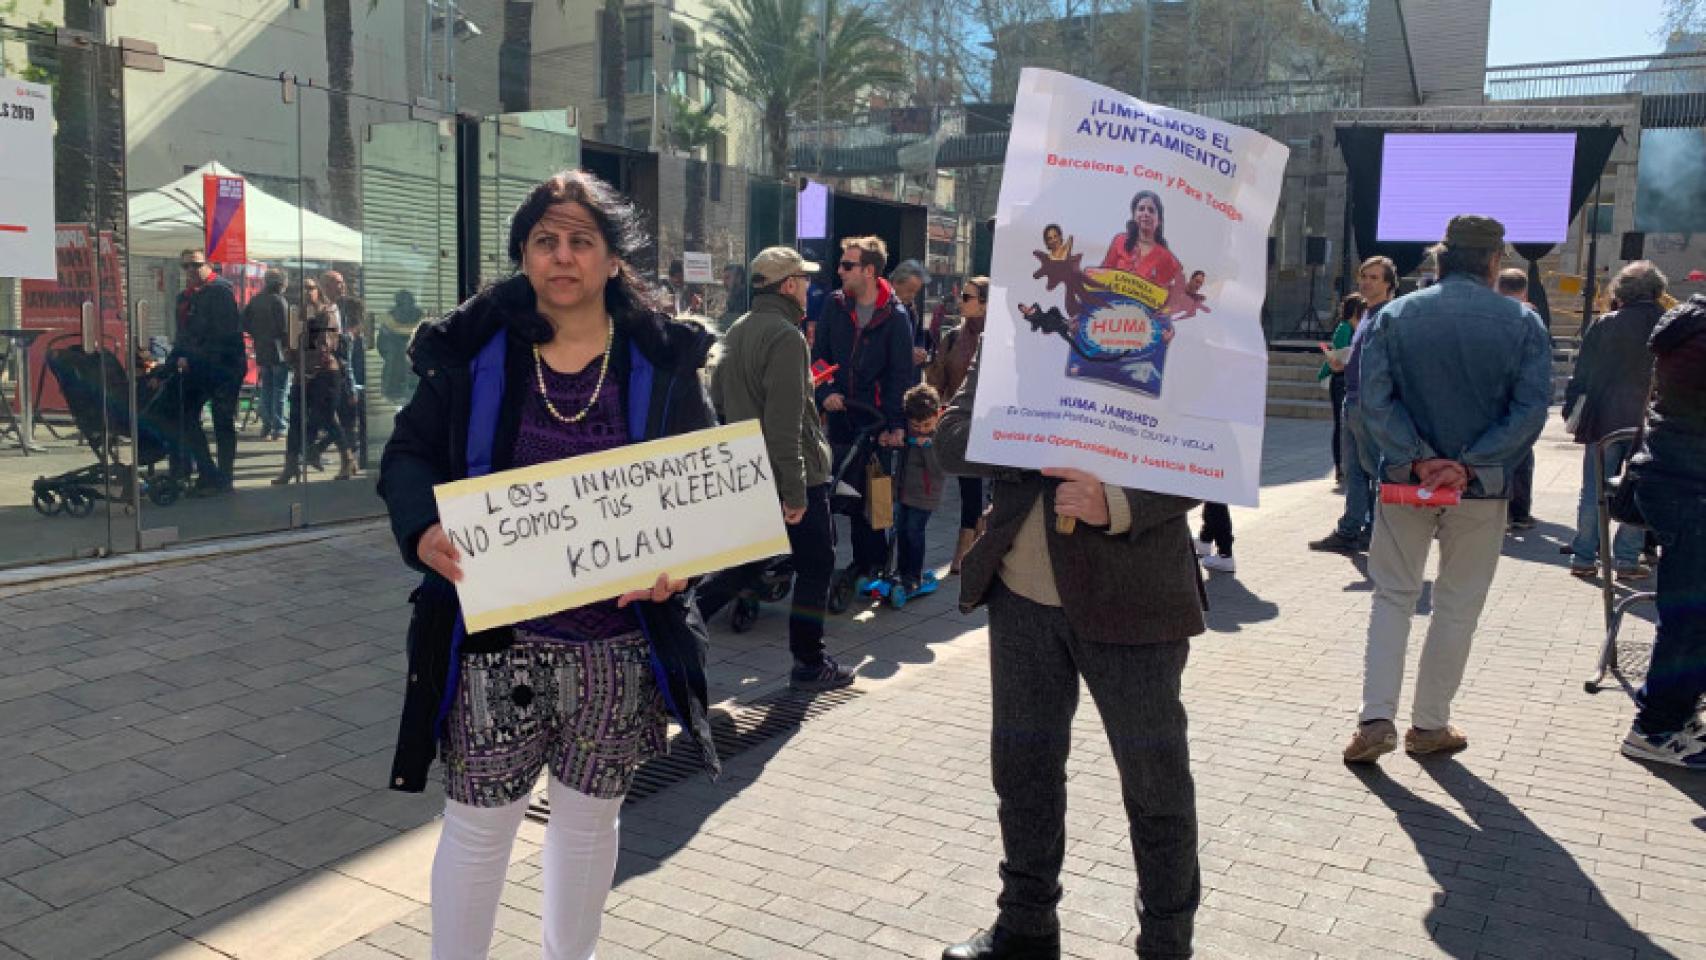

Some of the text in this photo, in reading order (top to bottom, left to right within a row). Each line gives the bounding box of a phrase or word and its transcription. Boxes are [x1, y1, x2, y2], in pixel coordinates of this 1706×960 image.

[1077, 118, 1237, 178] AYUNTAMIENTO!
[1091, 99, 1233, 154] ¡LIMPIEMOS EL
[1047, 153, 1128, 176] Barcelona,
[1133, 164, 1163, 181] Con
[1166, 176, 1176, 188] y
[1177, 177, 1203, 200] Para
[1091, 318, 1146, 336] HUMA
[1060, 397, 1159, 427] HUMA JAMSHED
[1033, 432, 1046, 443] de
[1047, 434, 1129, 460] Oportunidades
[1131, 454, 1139, 465] y
[1141, 455, 1186, 472] Justicia
[1188, 463, 1224, 479] Social
[1140, 429, 1179, 446] CIUTAT
[1181, 438, 1214, 452] VELLA
[572, 441, 733, 500] INMIGRANTES
[448, 454, 768, 558] NO SOMOS TUS KLEENEX
[567, 527, 674, 578] KOLAU
